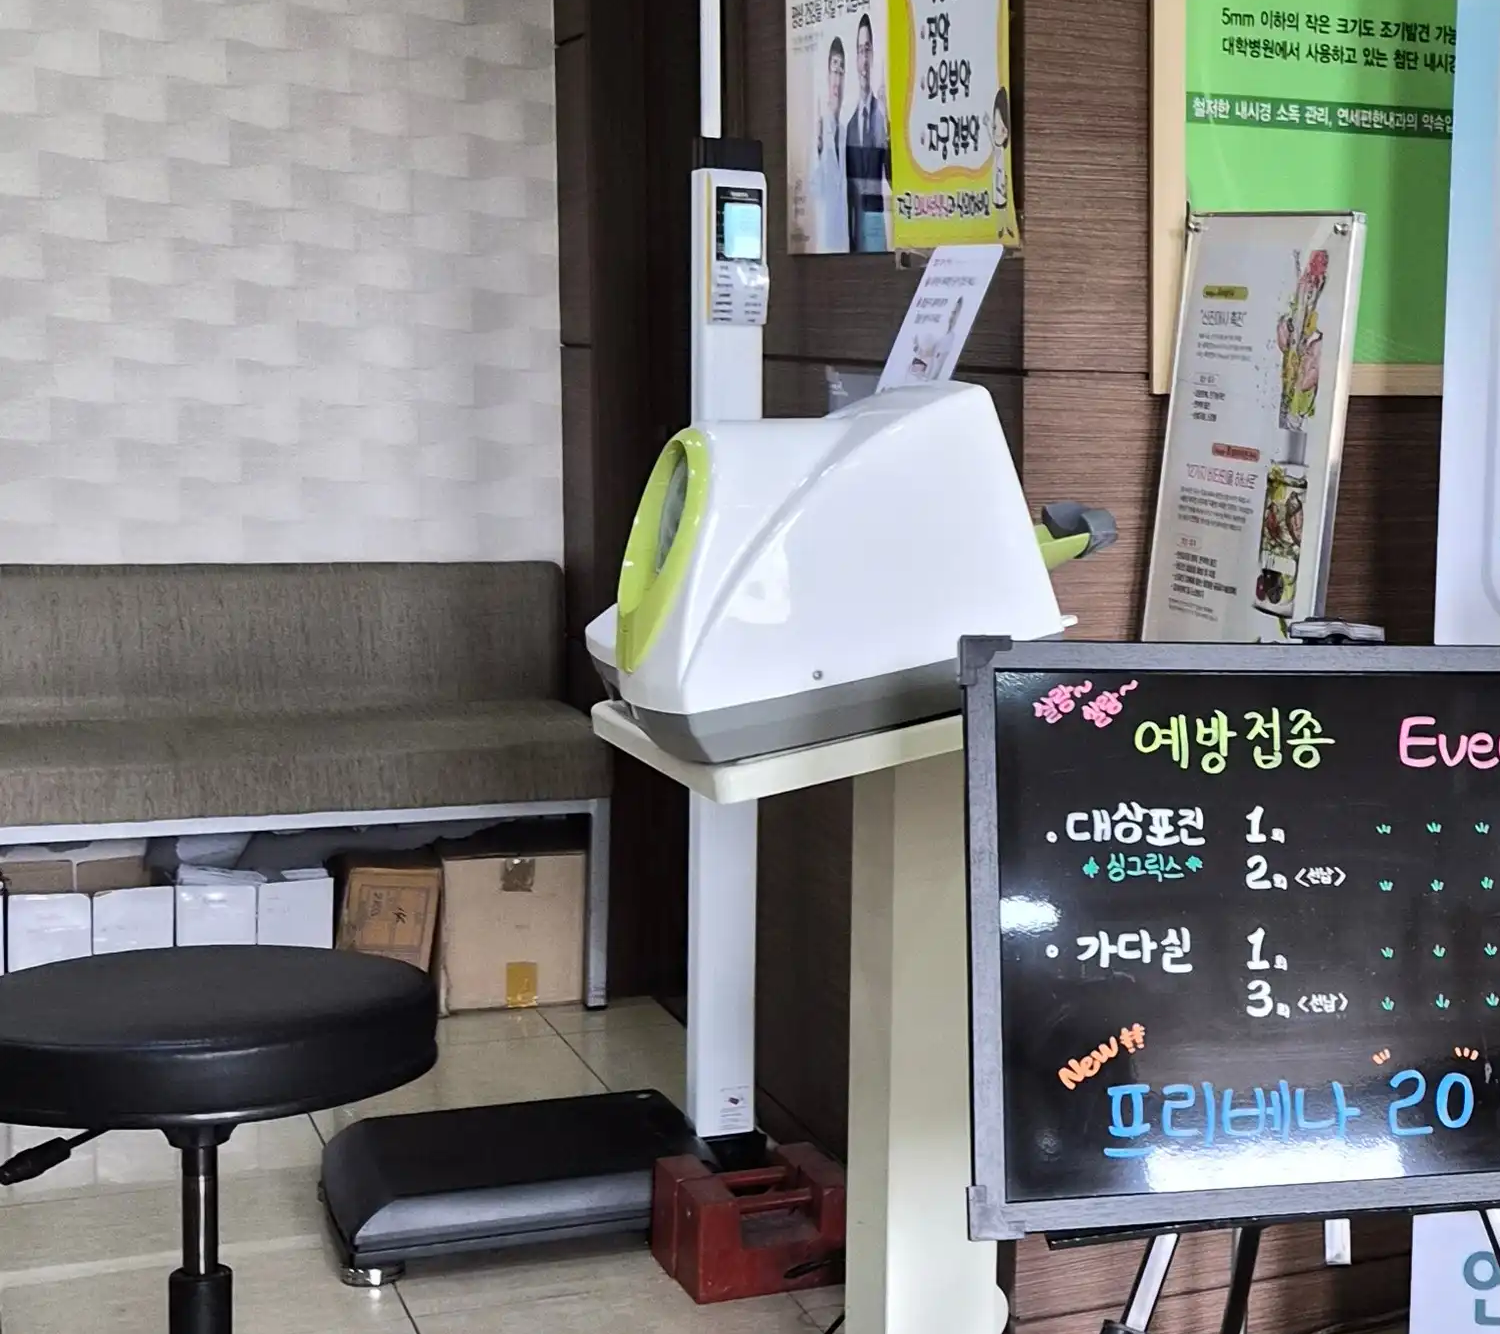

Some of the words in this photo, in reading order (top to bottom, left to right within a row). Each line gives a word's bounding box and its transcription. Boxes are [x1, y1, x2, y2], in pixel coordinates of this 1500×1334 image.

[1221, 7, 1256, 28] 5mm
[1260, 9, 1300, 33] 이하의
[1305, 13, 1331, 36] 작은
[1336, 17, 1376, 38] 크기도
[1379, 19, 1431, 44] 조기발견
[1222, 35, 1301, 62] 대학병원에서
[1305, 43, 1358, 67] 사용하고
[1362, 46, 1389, 69] 있는
[1393, 49, 1420, 72] 첨단
[1235, 100, 1272, 122] 내시경
[1276, 103, 1301, 125] 소독
[1134, 709, 1336, 774] 예방접종
[1066, 801, 1206, 846] 대상포진
[1107, 852, 1185, 883] 싱그릭스
[1076, 926, 1193, 973] 가다실
[1103, 1078, 1361, 1159] 프리베나
[1388, 1069, 1475, 1137] 20
